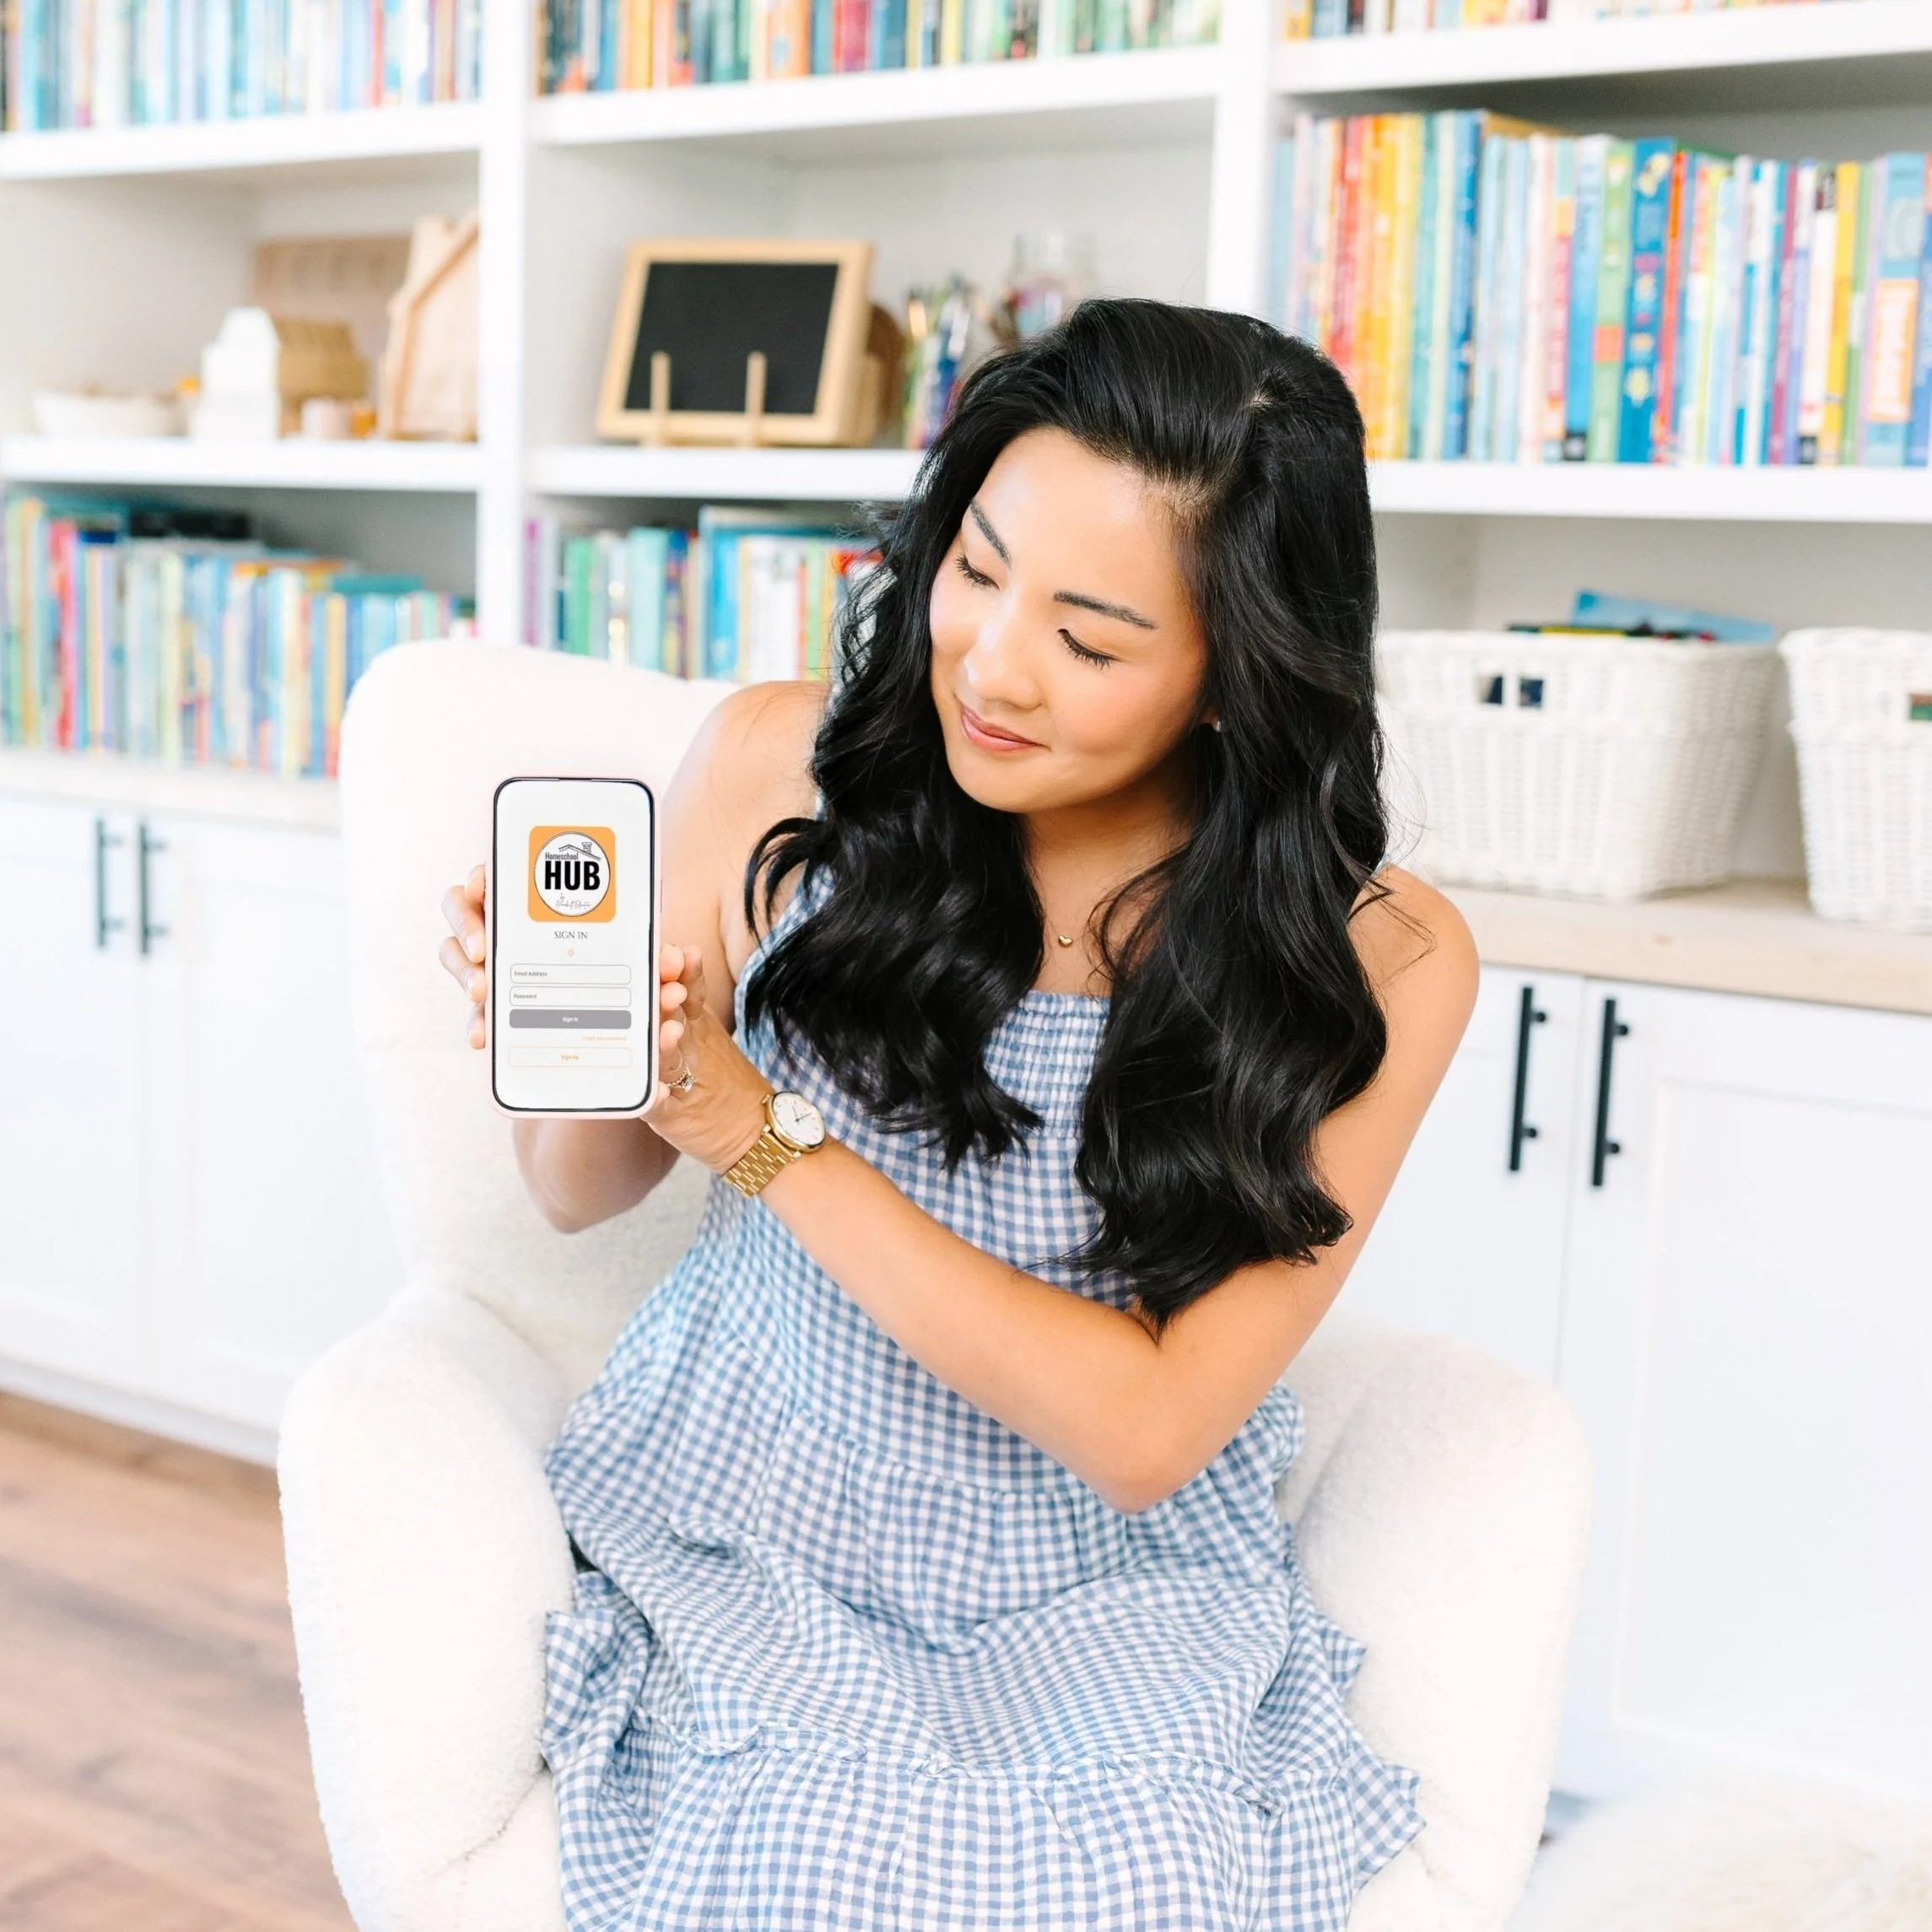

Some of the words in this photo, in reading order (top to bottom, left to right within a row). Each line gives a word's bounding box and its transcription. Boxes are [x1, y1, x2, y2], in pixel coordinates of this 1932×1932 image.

[545, 852, 579, 861] Homeschool
[545, 861, 601, 891] HUB
[554, 931, 575, 939] SIGN
[577, 931, 588, 939] IN
